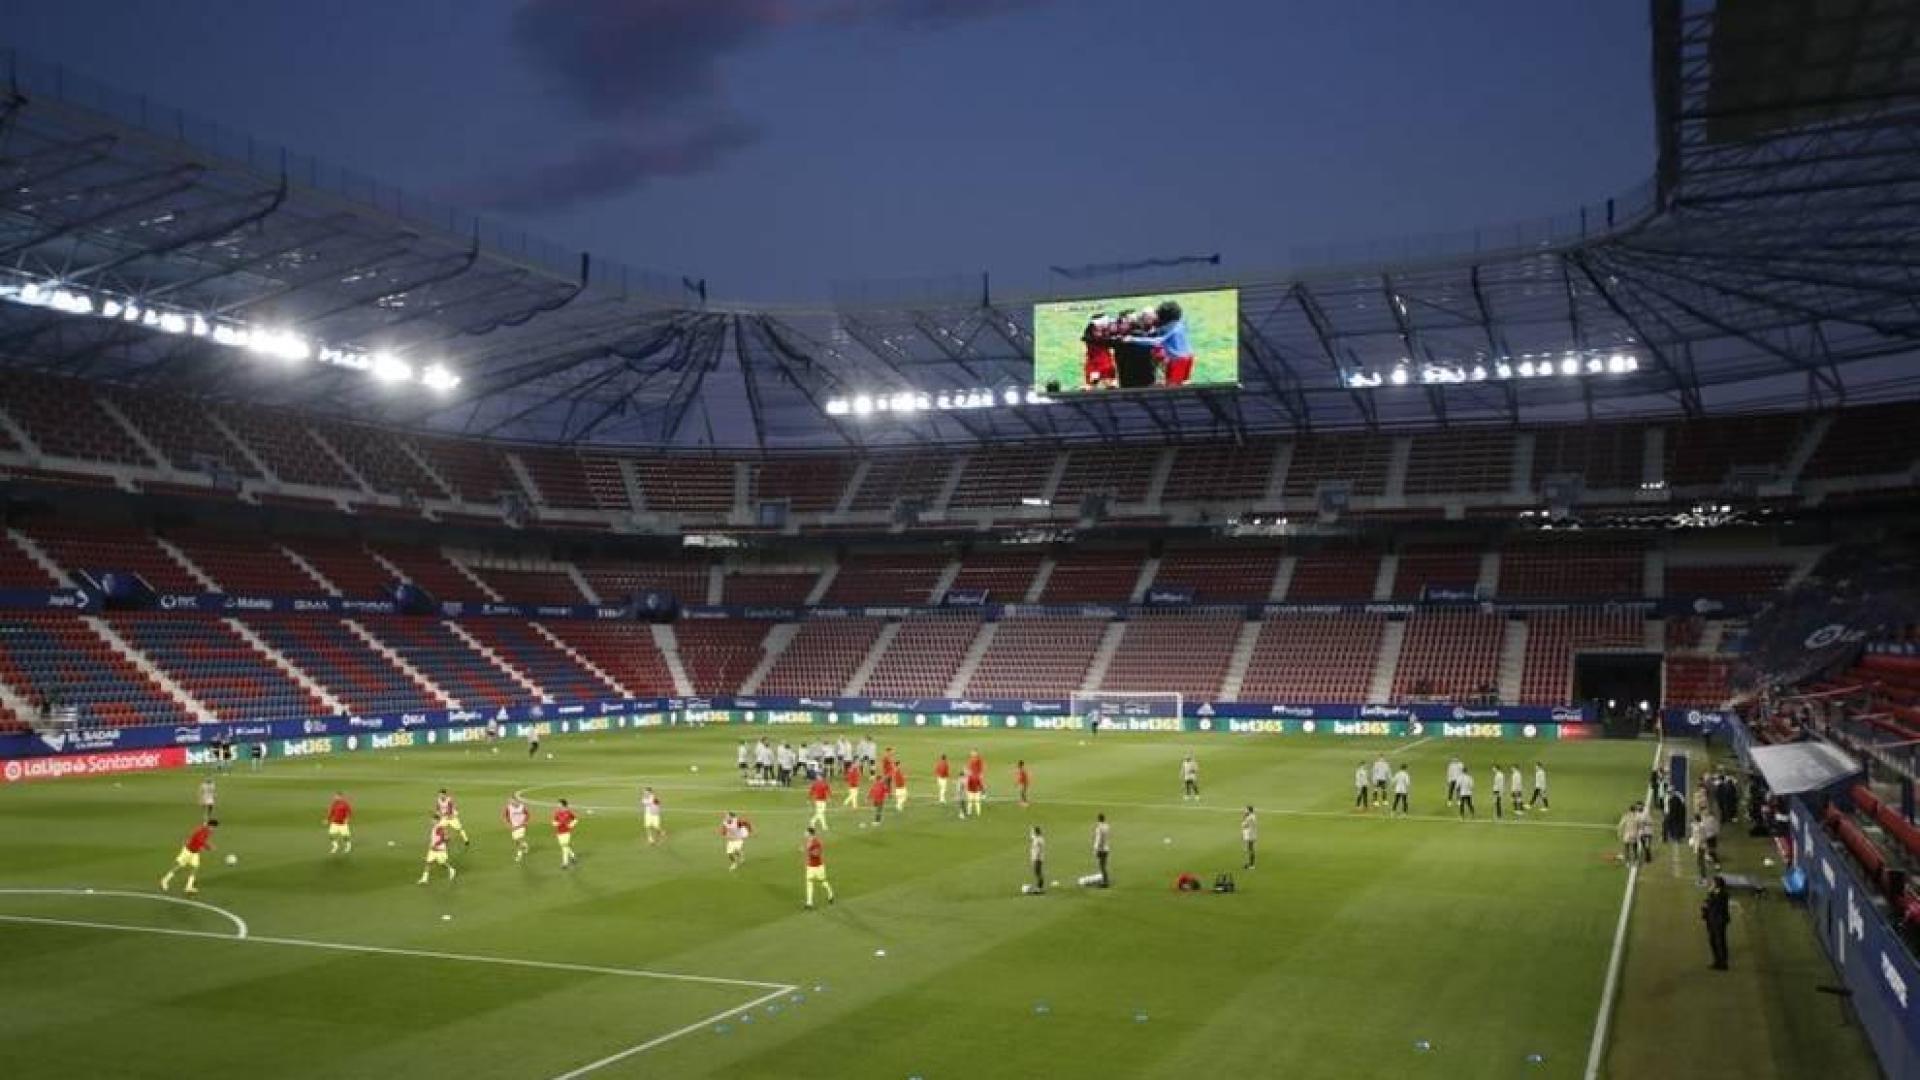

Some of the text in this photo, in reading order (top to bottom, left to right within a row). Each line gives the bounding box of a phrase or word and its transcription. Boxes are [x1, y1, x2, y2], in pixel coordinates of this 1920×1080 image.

[853, 713, 898, 726] bet365
[942, 714, 989, 727] bet365
[1229, 718, 1282, 732] bet365
[1334, 721, 1391, 735] bet365
[1443, 723, 1501, 737] bet365
[285, 739, 331, 755] bet365
[372, 733, 414, 748] bet365
[25, 752, 159, 776] LaLiga Santander
